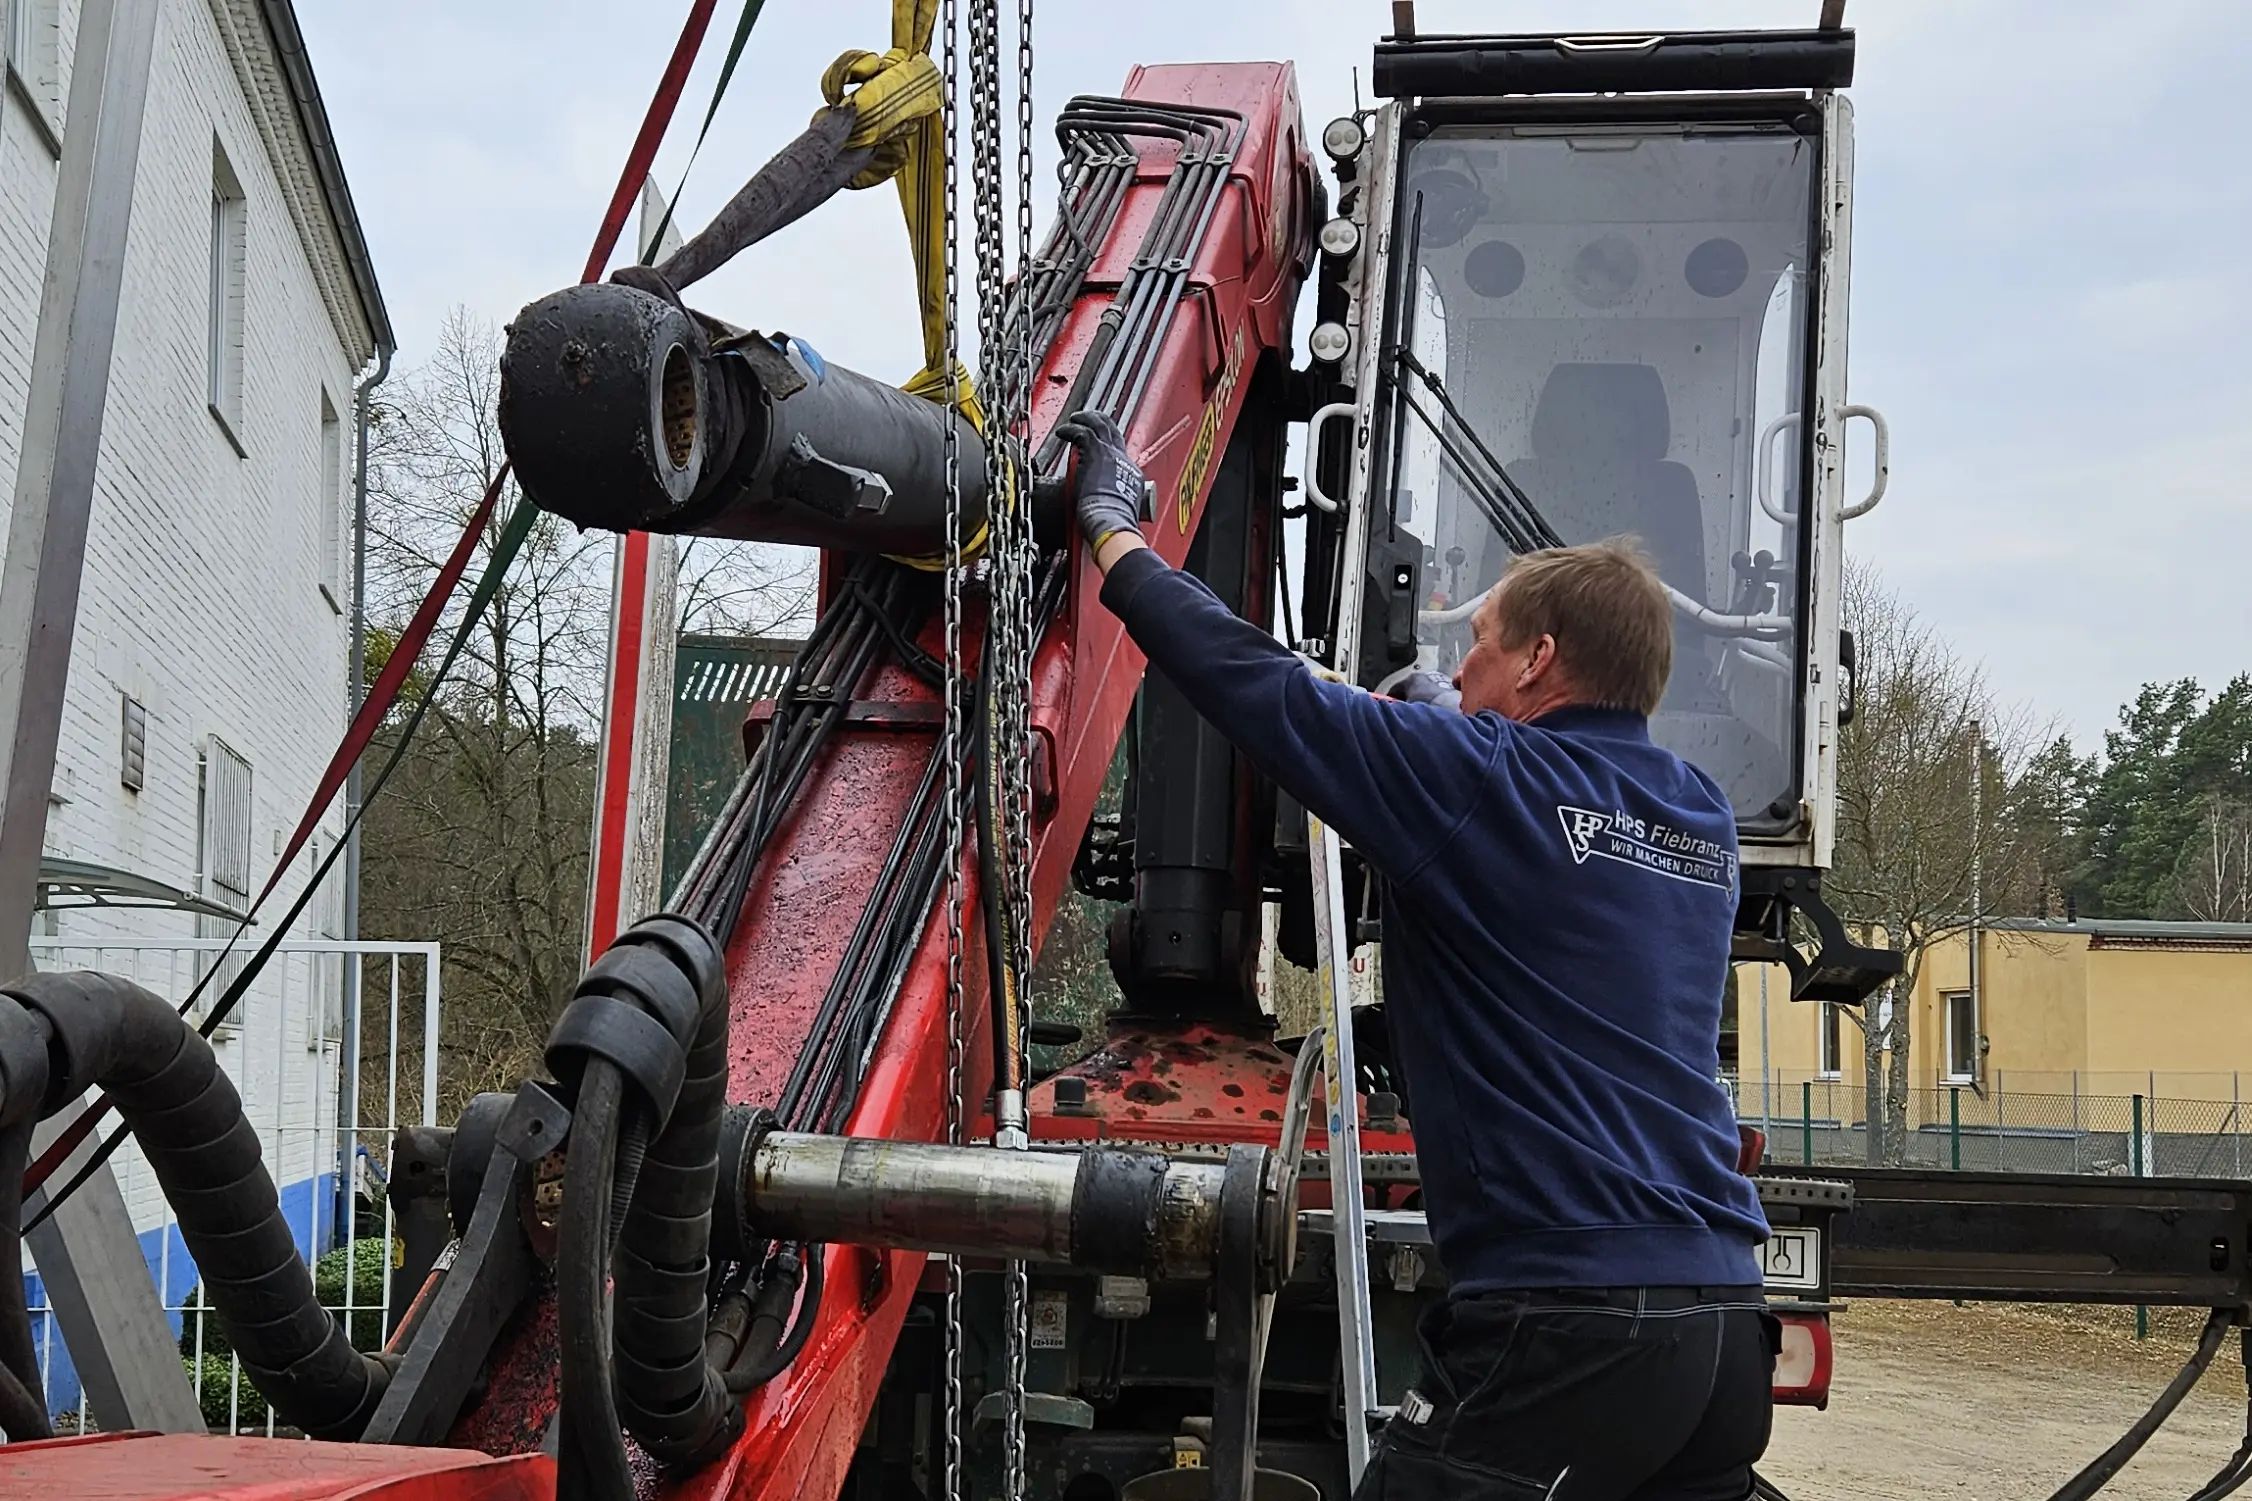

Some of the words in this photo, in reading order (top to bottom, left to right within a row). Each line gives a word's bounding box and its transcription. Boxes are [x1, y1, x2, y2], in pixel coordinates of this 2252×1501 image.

[1615, 809, 1646, 839] HPS
[1650, 824, 1721, 858] Fiebranz
[1611, 838, 1633, 857] WIR
[1635, 847, 1681, 873] MACHEN
[1683, 862, 1719, 880] DRUCK
